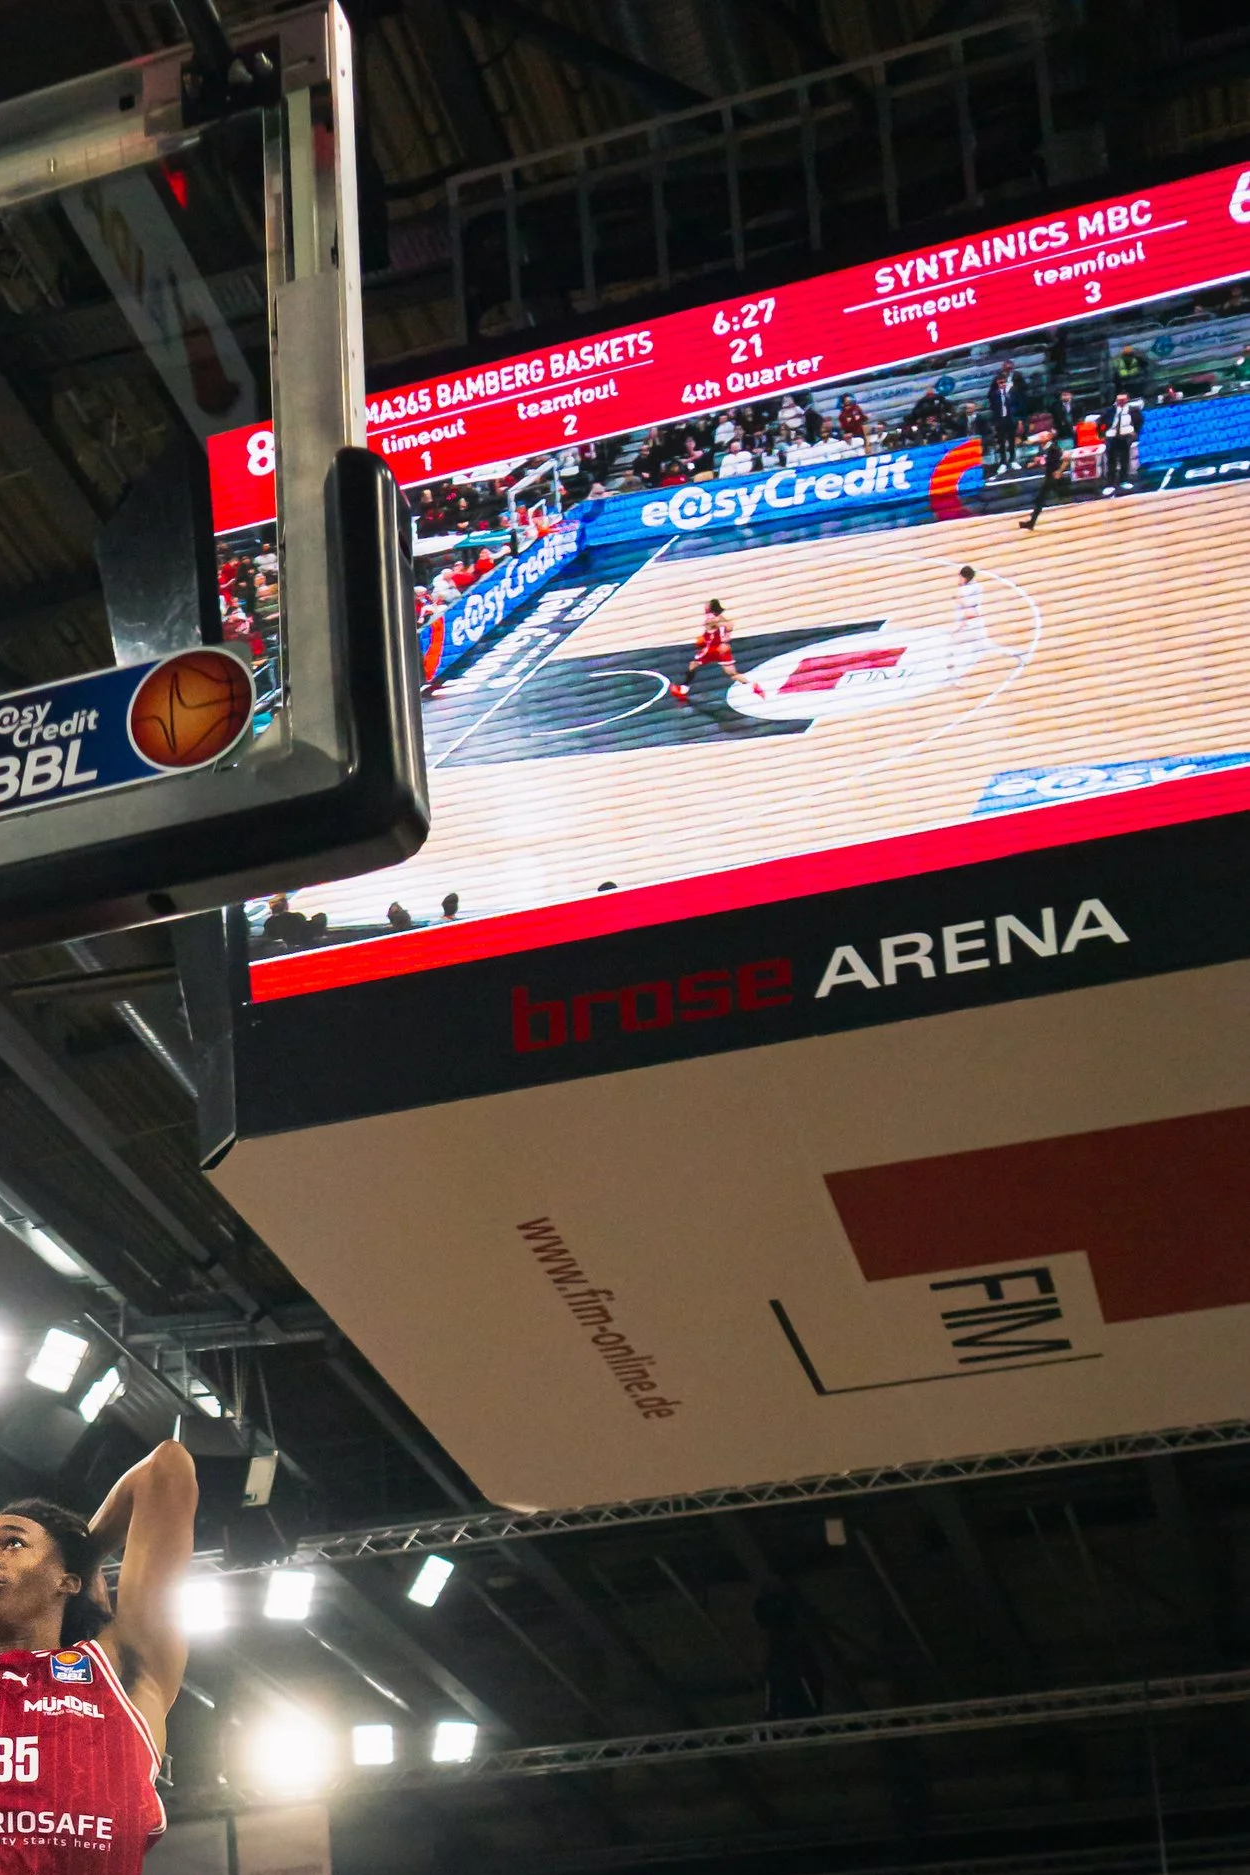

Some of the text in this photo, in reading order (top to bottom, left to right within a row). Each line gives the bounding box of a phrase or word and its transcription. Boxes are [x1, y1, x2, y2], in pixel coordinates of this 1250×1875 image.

[874, 200, 1153, 294] SYNTAINICS MBC
[882, 241, 1147, 326] timeout teamfoul
[926, 280, 1102, 344] 1 3
[712, 296, 776, 336] 6:27
[436, 358, 545, 411] BAMBERG
[550, 330, 655, 378] BASKETS
[680, 354, 824, 405] 4th Quarter
[729, 333, 764, 365] 21
[381, 378, 619, 456] timeout teamfoul
[420, 414, 579, 472] 1 2
[12, 706, 100, 749] Credit
[510, 897, 1131, 1055] brose ARENA
[515, 1215, 677, 1423] www.fim-online.de
[928, 1264, 1073, 1366] FIM
[22, 1694, 105, 1720] MÜNDEL
[22, 1835, 68, 1848] starts
[73, 1837, 112, 1852] here!
